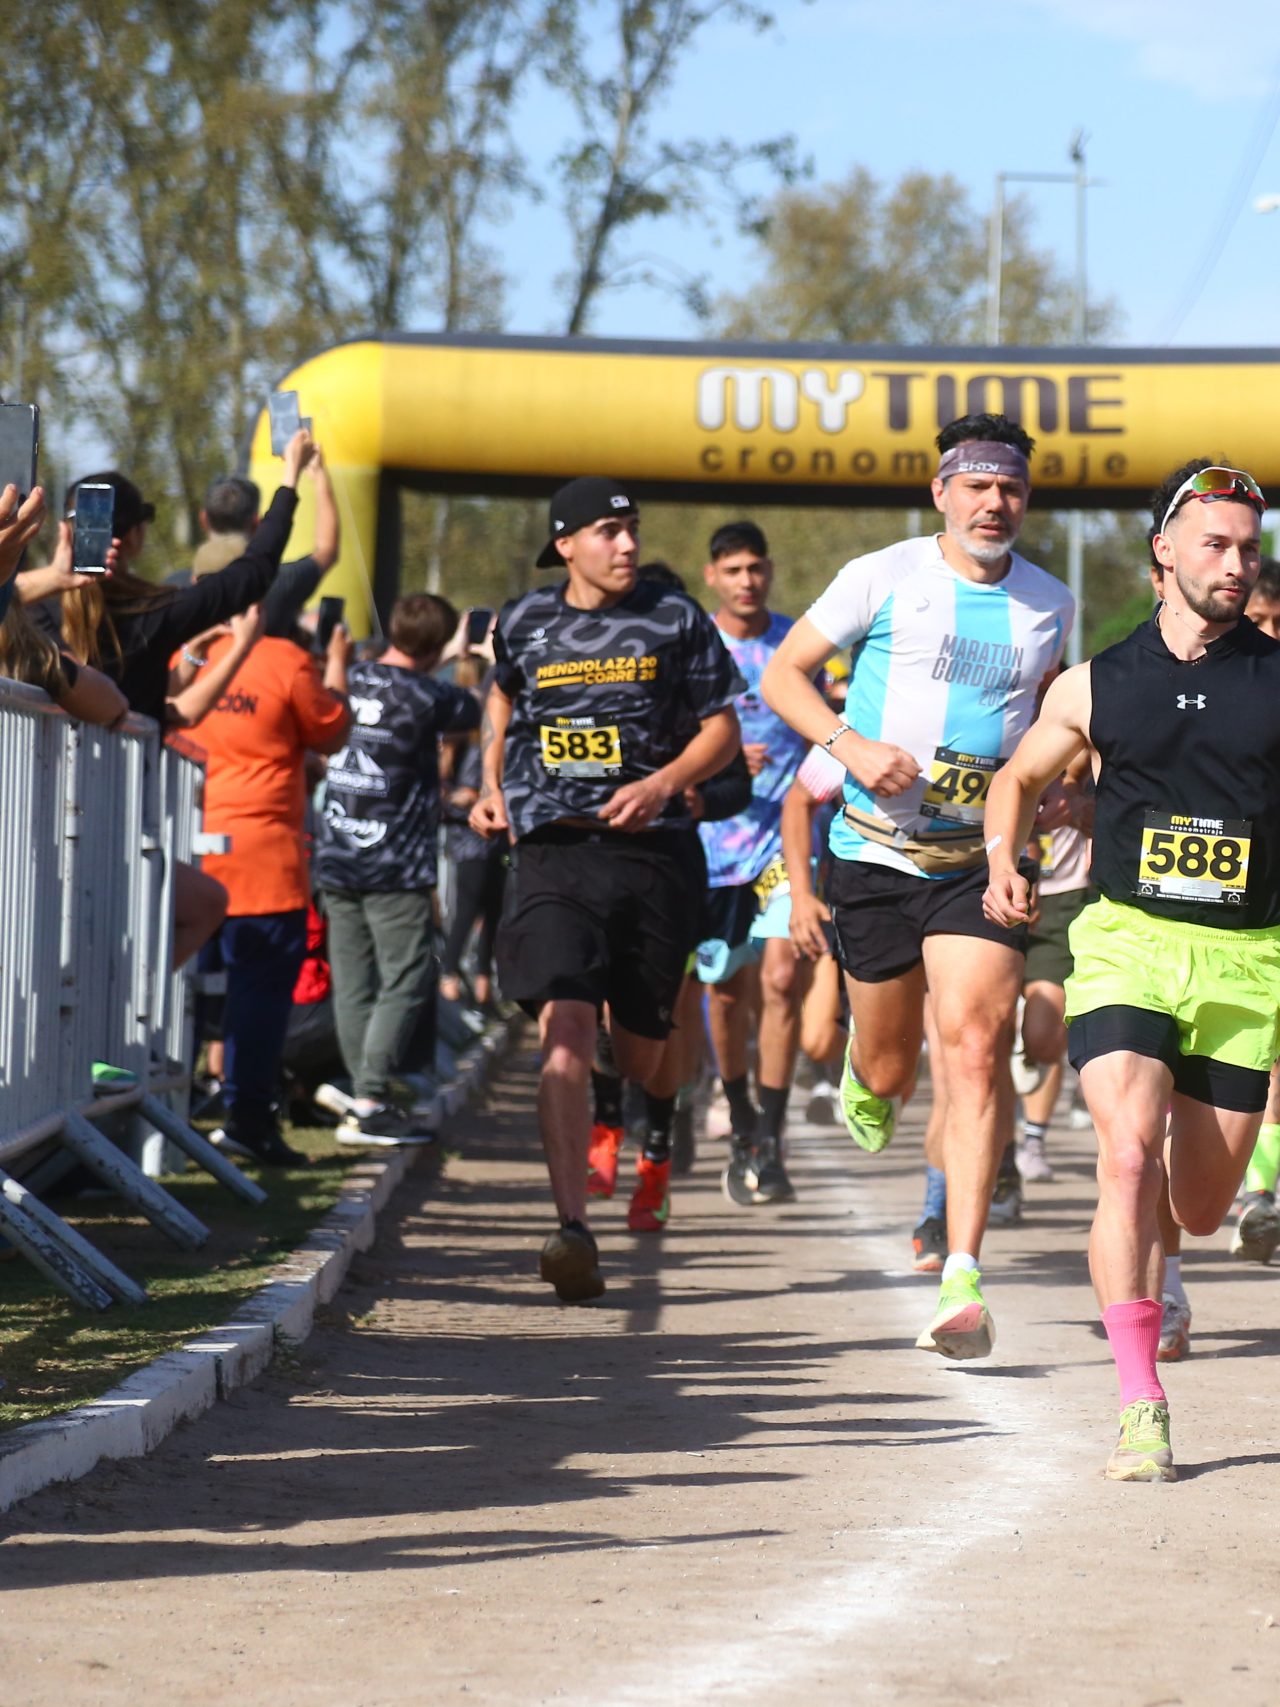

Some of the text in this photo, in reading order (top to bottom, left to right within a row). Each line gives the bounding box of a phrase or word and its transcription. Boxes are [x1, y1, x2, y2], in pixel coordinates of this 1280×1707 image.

[702, 445, 1128, 487] cronomaje
[536, 656, 636, 680] MENDIOLAZA
[584, 669, 636, 685] CORRE
[548, 730, 614, 761] 583
[932, 768, 989, 804] 49
[1169, 825, 1224, 836] cronometraje
[1170, 815, 1224, 830] MYTIME
[1147, 832, 1242, 881] 588
